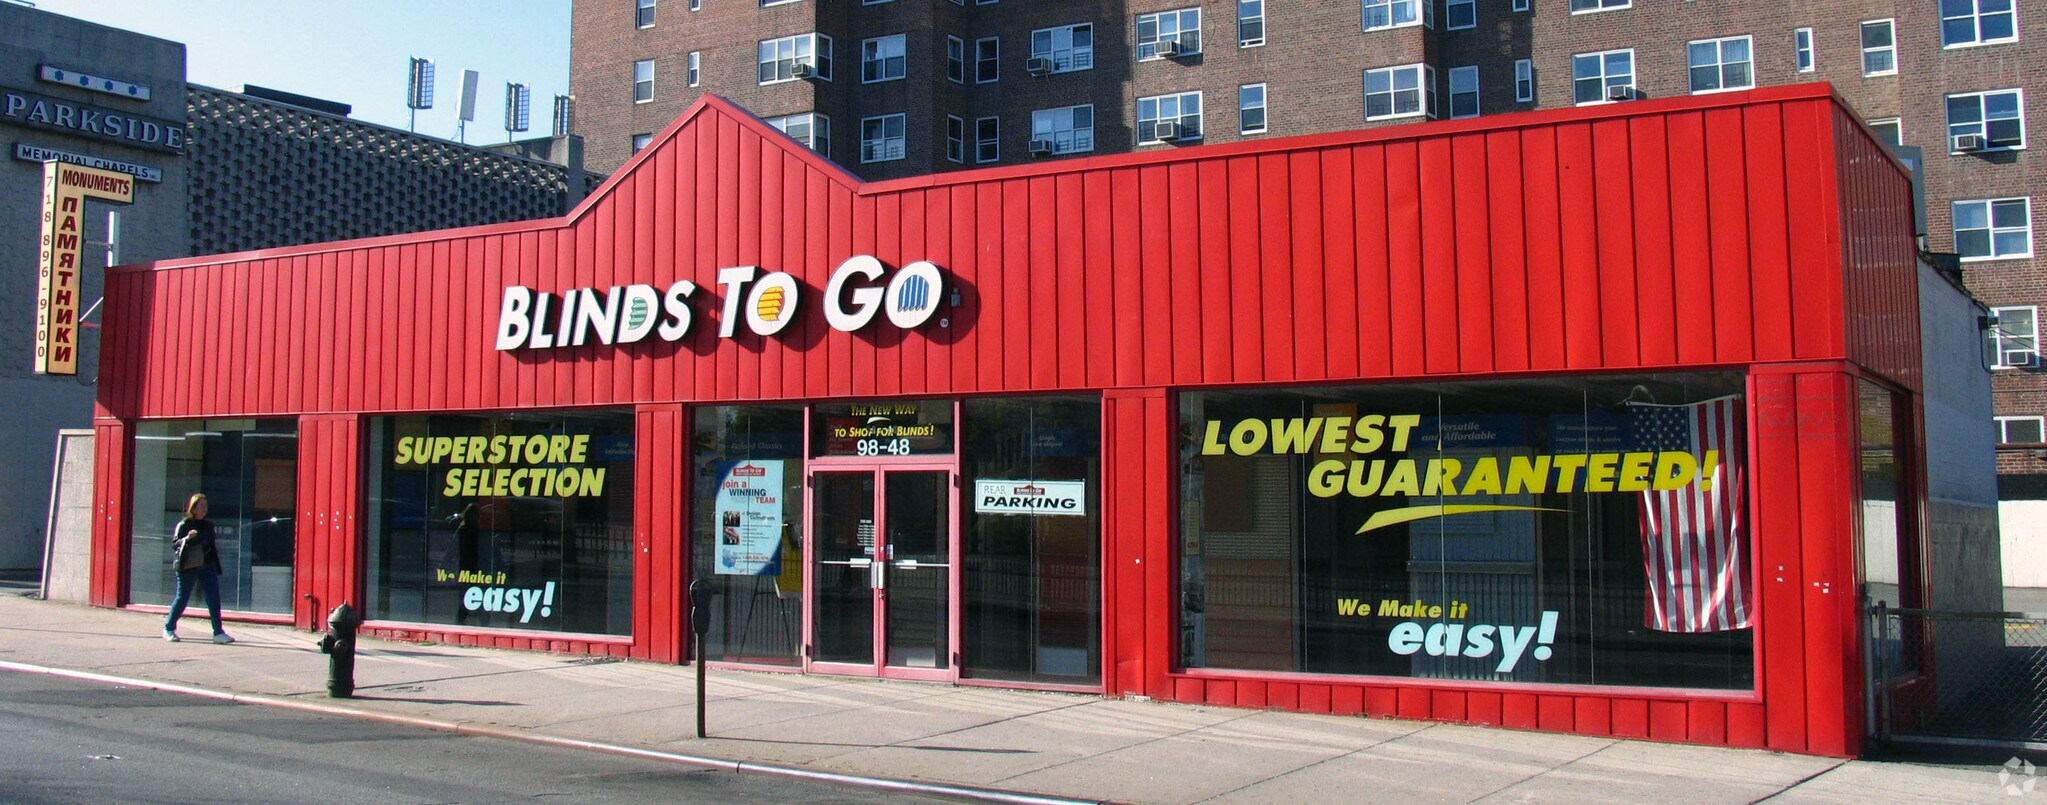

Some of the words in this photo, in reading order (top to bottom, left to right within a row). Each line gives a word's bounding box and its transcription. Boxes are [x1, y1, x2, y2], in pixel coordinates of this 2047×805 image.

[5, 93, 185, 149] PARKSIDE
[22, 147, 87, 166] MEMORIAL
[94, 160, 148, 177] CHAPELS
[62, 169, 130, 195] MONUMENTS
[54, 196, 78, 362] ПАМЯТНИКИ
[495, 279, 696, 351] BLINDS
[717, 266, 799, 338] TO
[823, 254, 943, 332] GO
[851, 403, 867, 416] THE
[869, 403, 891, 416] NEW
[895, 403, 917, 415] WAY
[834, 428, 846, 437] TO
[849, 426, 873, 437] SHOP
[876, 427, 894, 437] FOR
[897, 424, 934, 437] BLINDS!
[1201, 414, 1421, 456] LOWEST
[1443, 431, 1496, 441] Affordable
[394, 434, 590, 464] SUPERSTORE
[857, 438, 910, 456] 98-48
[443, 467, 605, 497] SELECTION
[722, 479, 739, 489] join
[1307, 450, 1719, 498] GUARANTEED!
[729, 488, 766, 496] WINNING
[983, 496, 1077, 509] PARKING
[984, 485, 1006, 494] REAR
[458, 570, 492, 584] Make
[496, 571, 507, 585] it
[463, 581, 556, 623] easy!
[1337, 599, 1371, 616] We
[1378, 600, 1442, 618] Make
[1450, 600, 1468, 619] it
[1388, 611, 1559, 673] easy!
